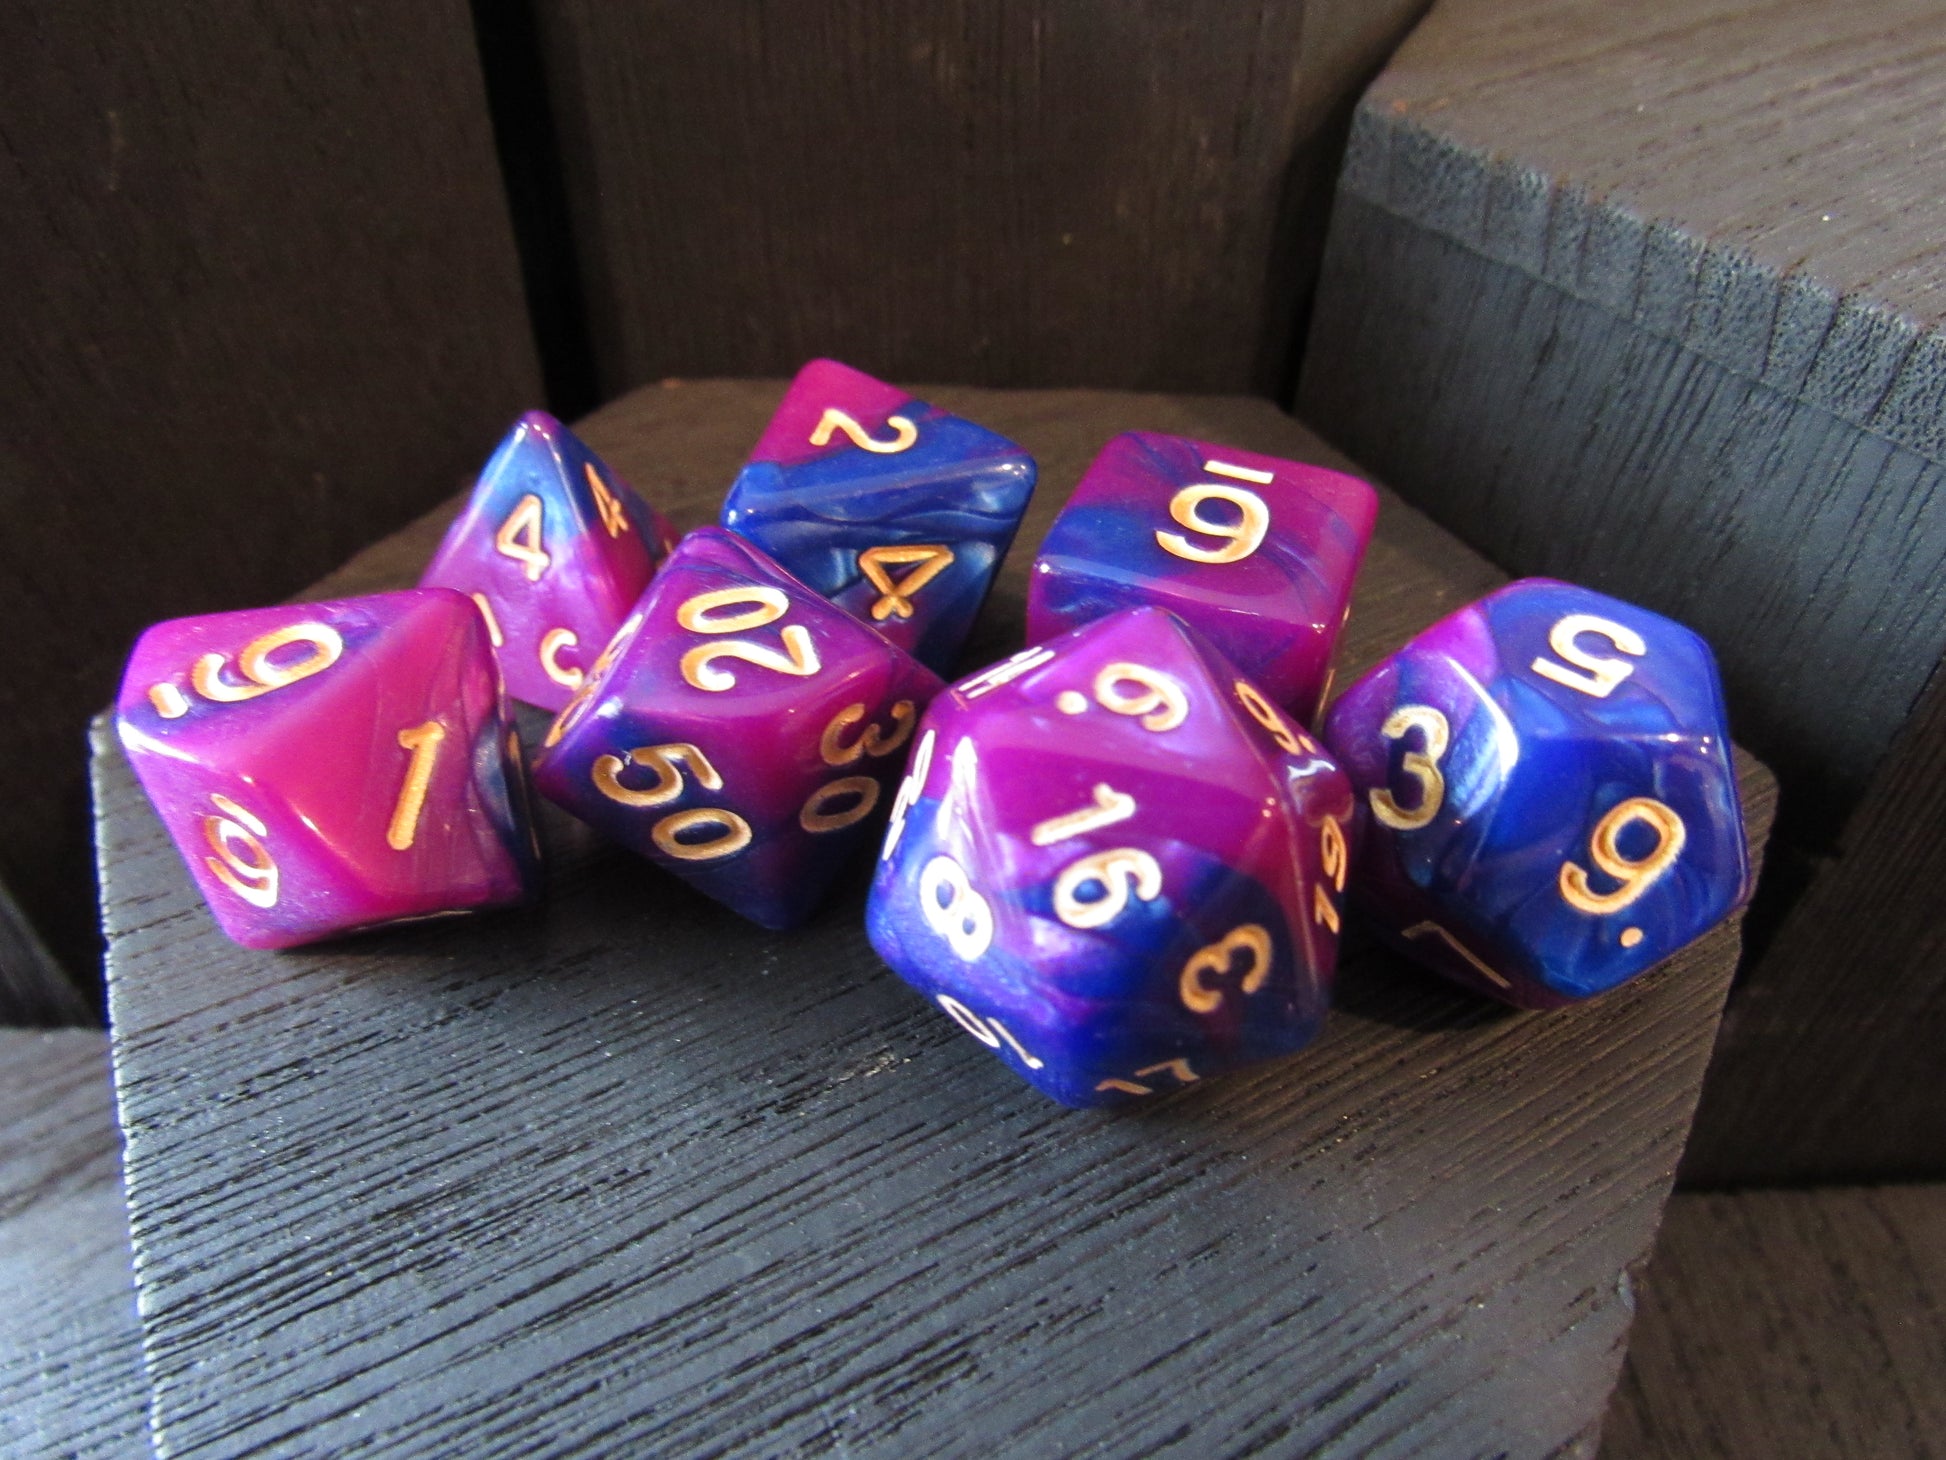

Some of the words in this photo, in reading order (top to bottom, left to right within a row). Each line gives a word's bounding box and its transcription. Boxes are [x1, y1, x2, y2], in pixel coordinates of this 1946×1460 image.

[810, 409, 918, 453] 2
[496, 493, 550, 581] 4
[584, 461, 629, 539] 4
[858, 545, 954, 621] 4
[676, 585, 821, 692] 20
[1532, 614, 1648, 698] 5
[386, 720, 447, 851] 1
[592, 743, 753, 860] 50
[800, 699, 915, 833] 30
[1369, 704, 1450, 830] 3
[920, 855, 994, 962] 8
[1032, 782, 1162, 929] 16
[1180, 924, 1273, 1014] 3
